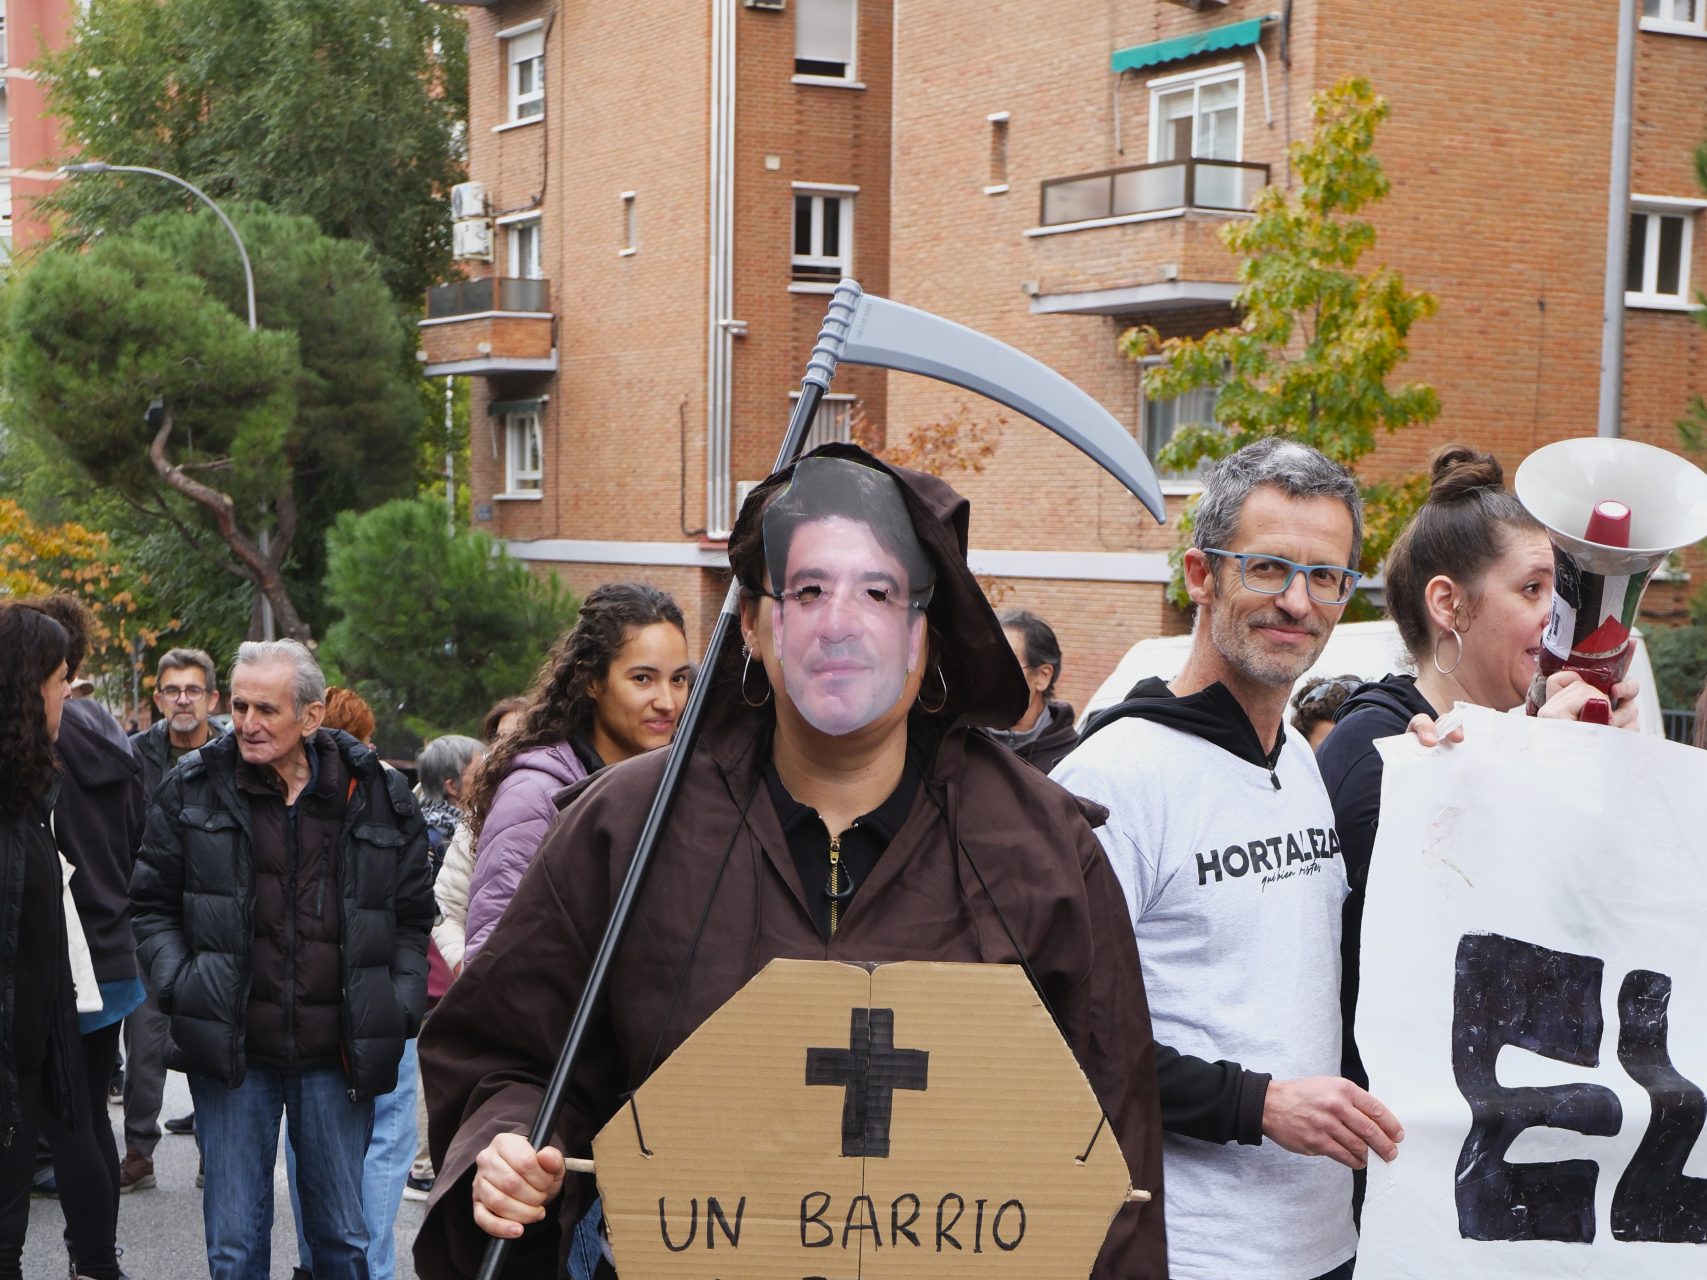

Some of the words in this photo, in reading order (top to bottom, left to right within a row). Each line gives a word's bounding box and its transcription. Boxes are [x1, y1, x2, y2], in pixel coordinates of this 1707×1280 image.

[1195, 827, 1341, 886] HORTALEZA
[1451, 928, 1707, 1245] EL
[659, 1195, 747, 1252] UN
[800, 1192, 1027, 1254] BARRIO
